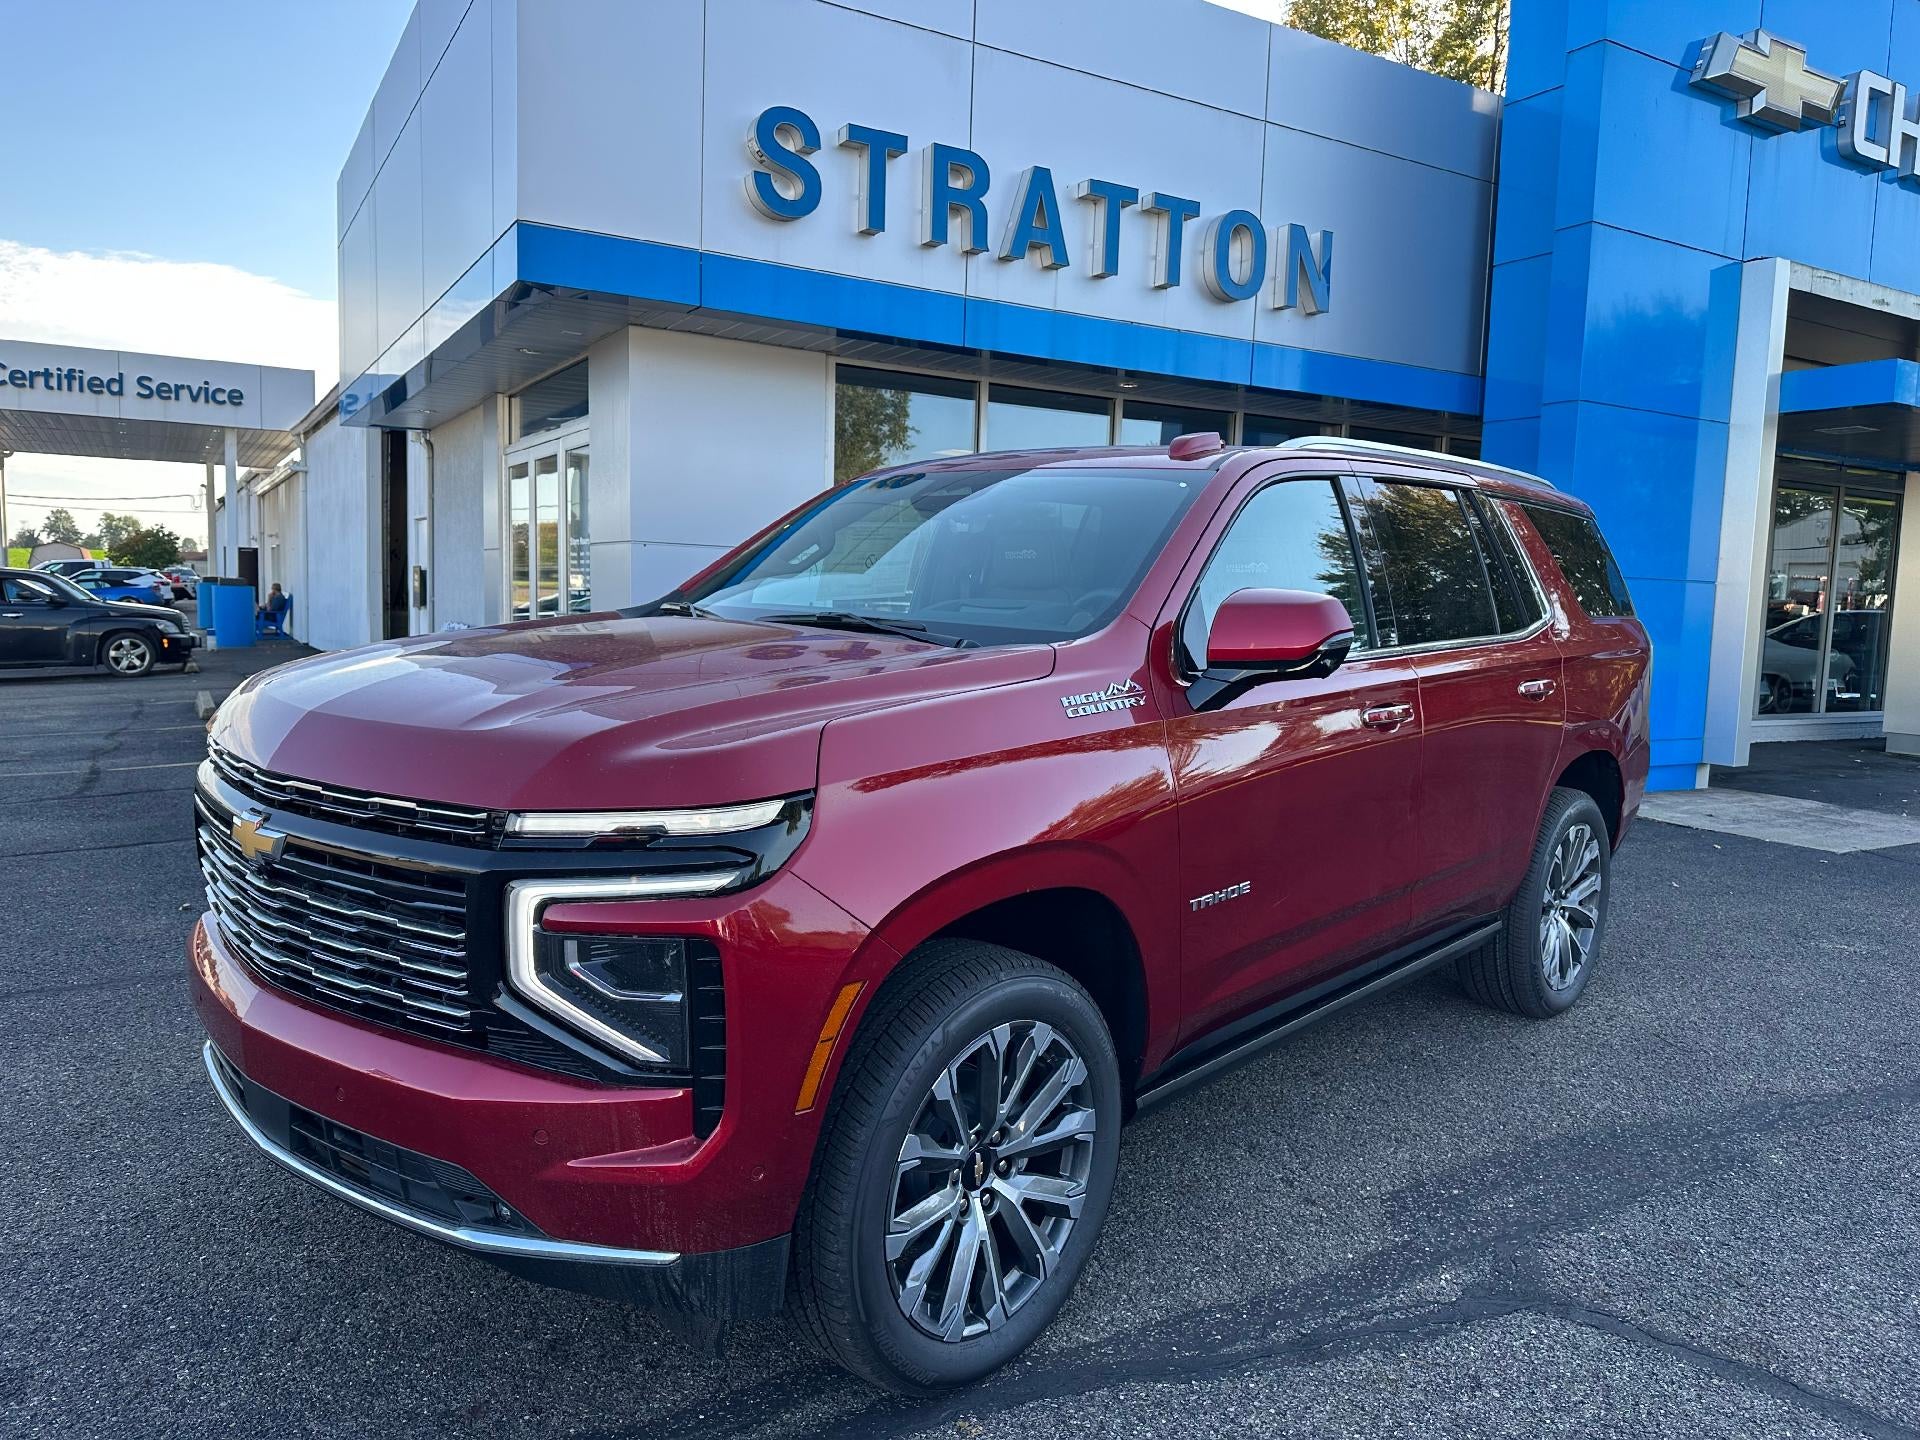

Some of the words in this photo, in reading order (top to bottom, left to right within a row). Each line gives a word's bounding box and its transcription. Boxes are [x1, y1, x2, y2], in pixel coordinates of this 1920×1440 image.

[745, 106, 1334, 316] STRATTON
[136, 375, 244, 406] Service
[1060, 690, 1107, 708] HIGH
[1065, 695, 1147, 719] COUNTRY
[1189, 880, 1251, 912] TAHOE
